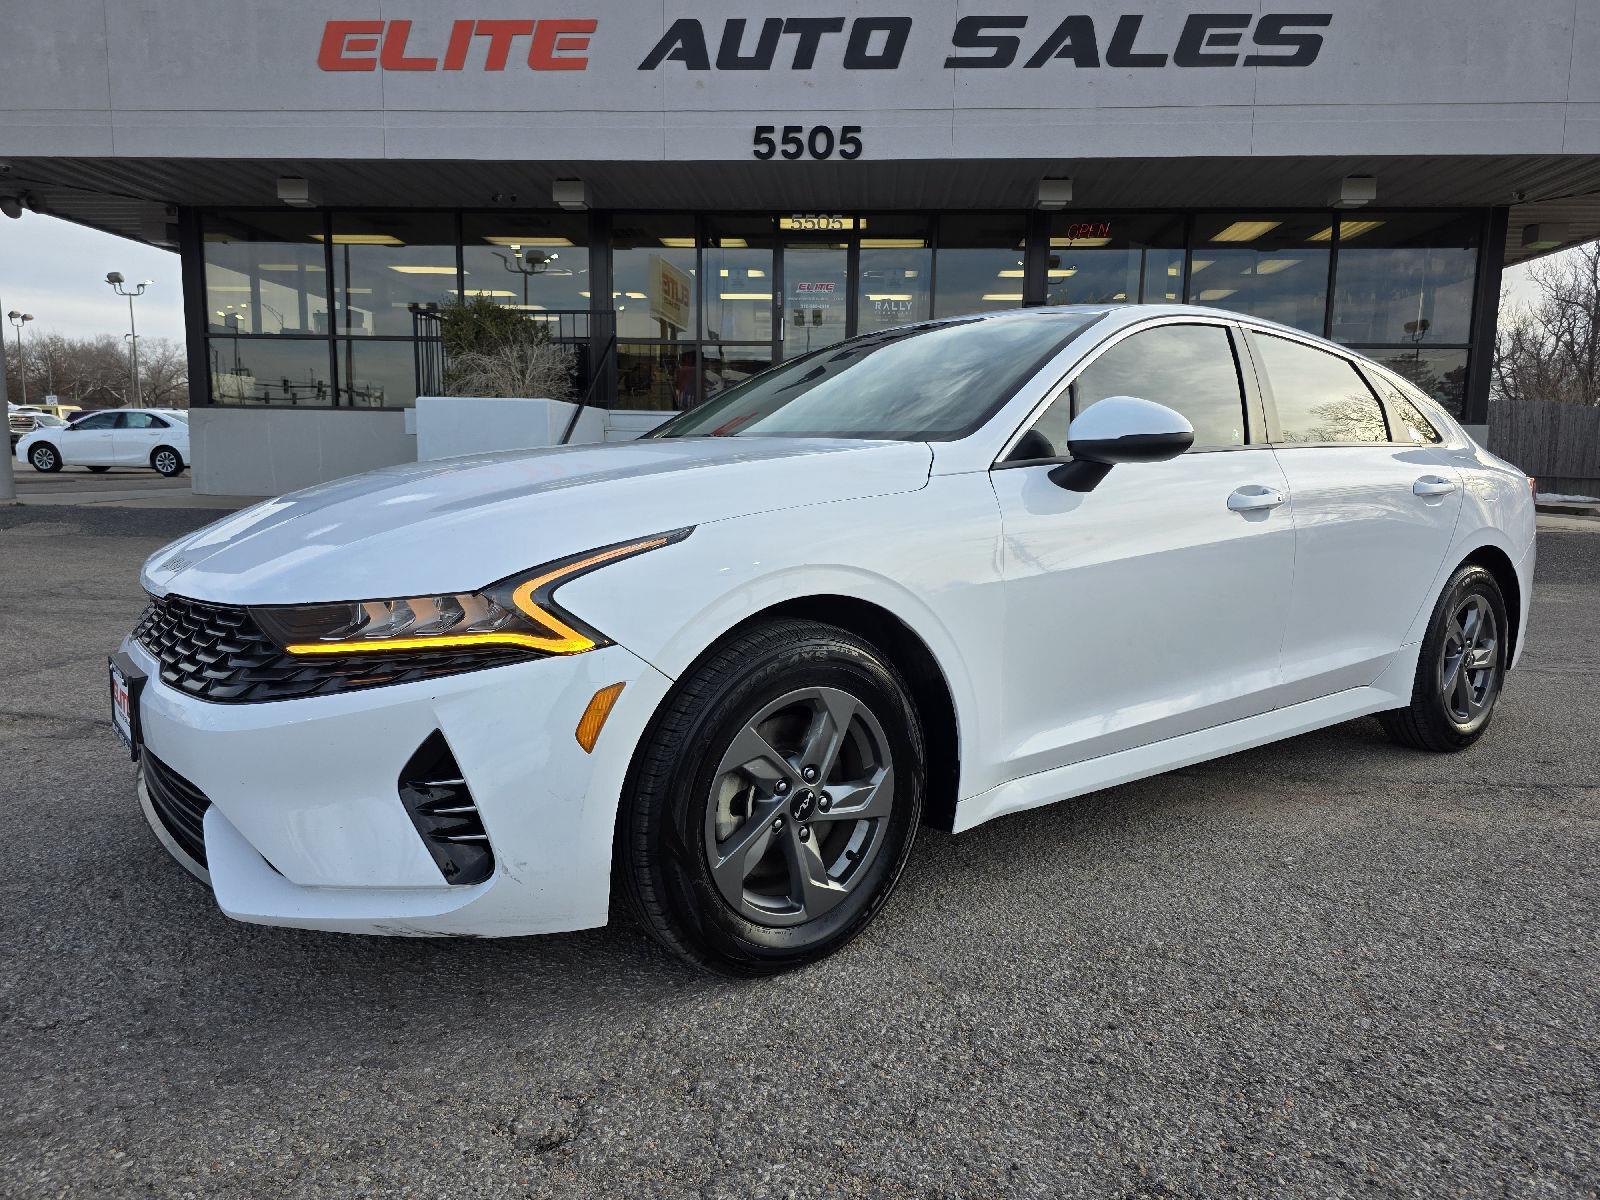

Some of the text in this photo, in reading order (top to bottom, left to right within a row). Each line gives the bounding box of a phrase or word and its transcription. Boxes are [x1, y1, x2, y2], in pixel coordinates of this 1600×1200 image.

[317, 13, 1332, 72] ELITE AUTO SALES
[752, 125, 863, 160] 5505
[790, 213, 843, 231] 5505
[1068, 222, 1111, 240] OPEN
[798, 282, 836, 291] ELITE
[874, 301, 913, 311] RALLY
